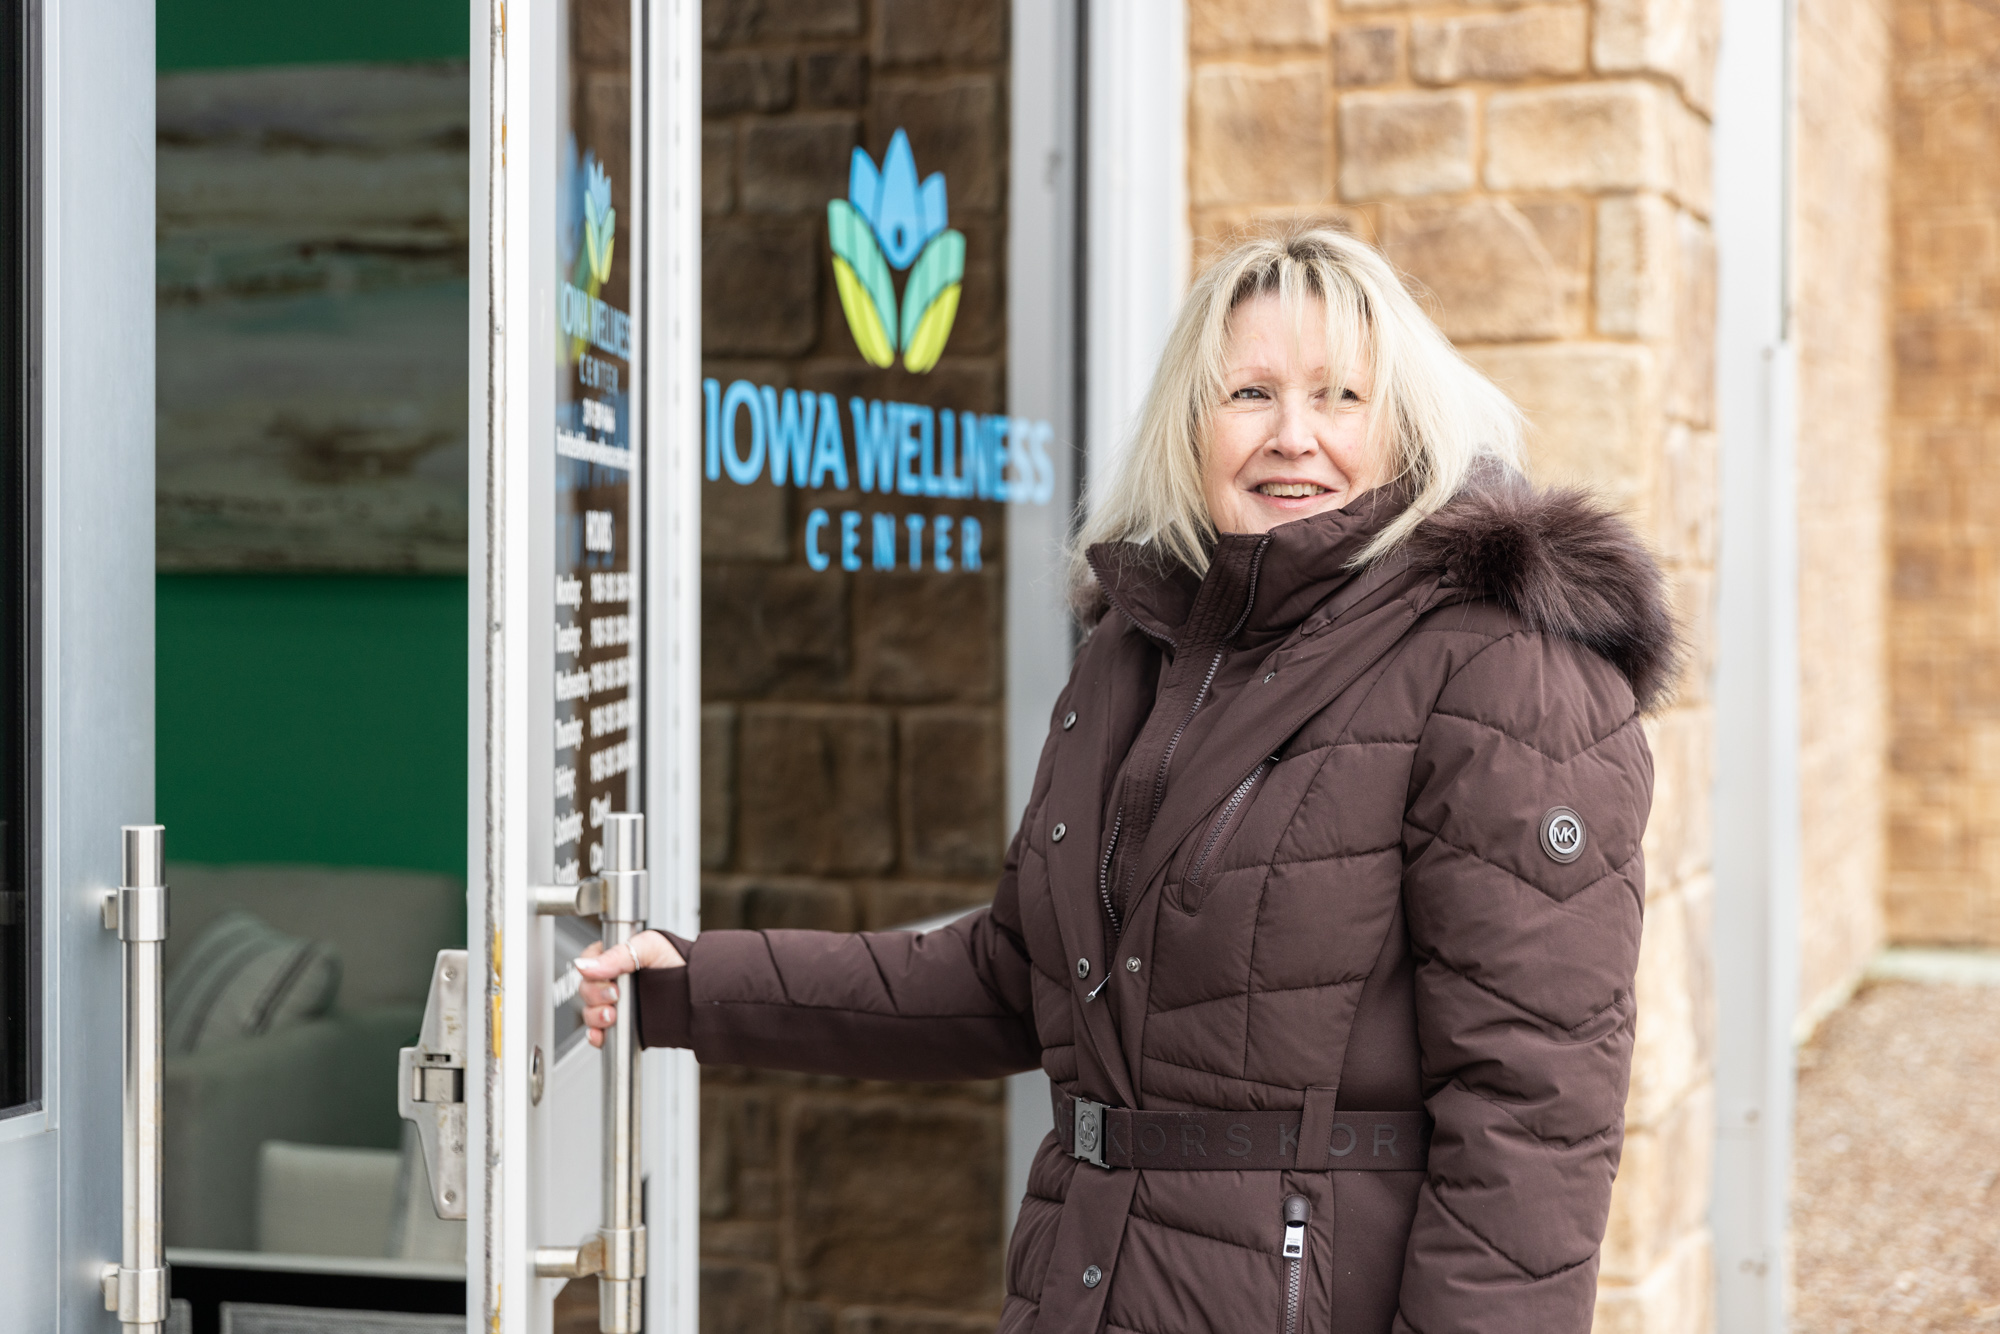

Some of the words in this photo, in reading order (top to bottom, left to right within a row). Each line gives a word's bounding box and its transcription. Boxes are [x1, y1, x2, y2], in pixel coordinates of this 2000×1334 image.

[579, 352, 618, 396] CENTER
[703, 377, 849, 490] IOWA
[850, 396, 1054, 505] WELLNESS
[804, 508, 983, 573] CENTER
[1553, 826, 1576, 843] MK
[1106, 1122, 1253, 1157] KORS
